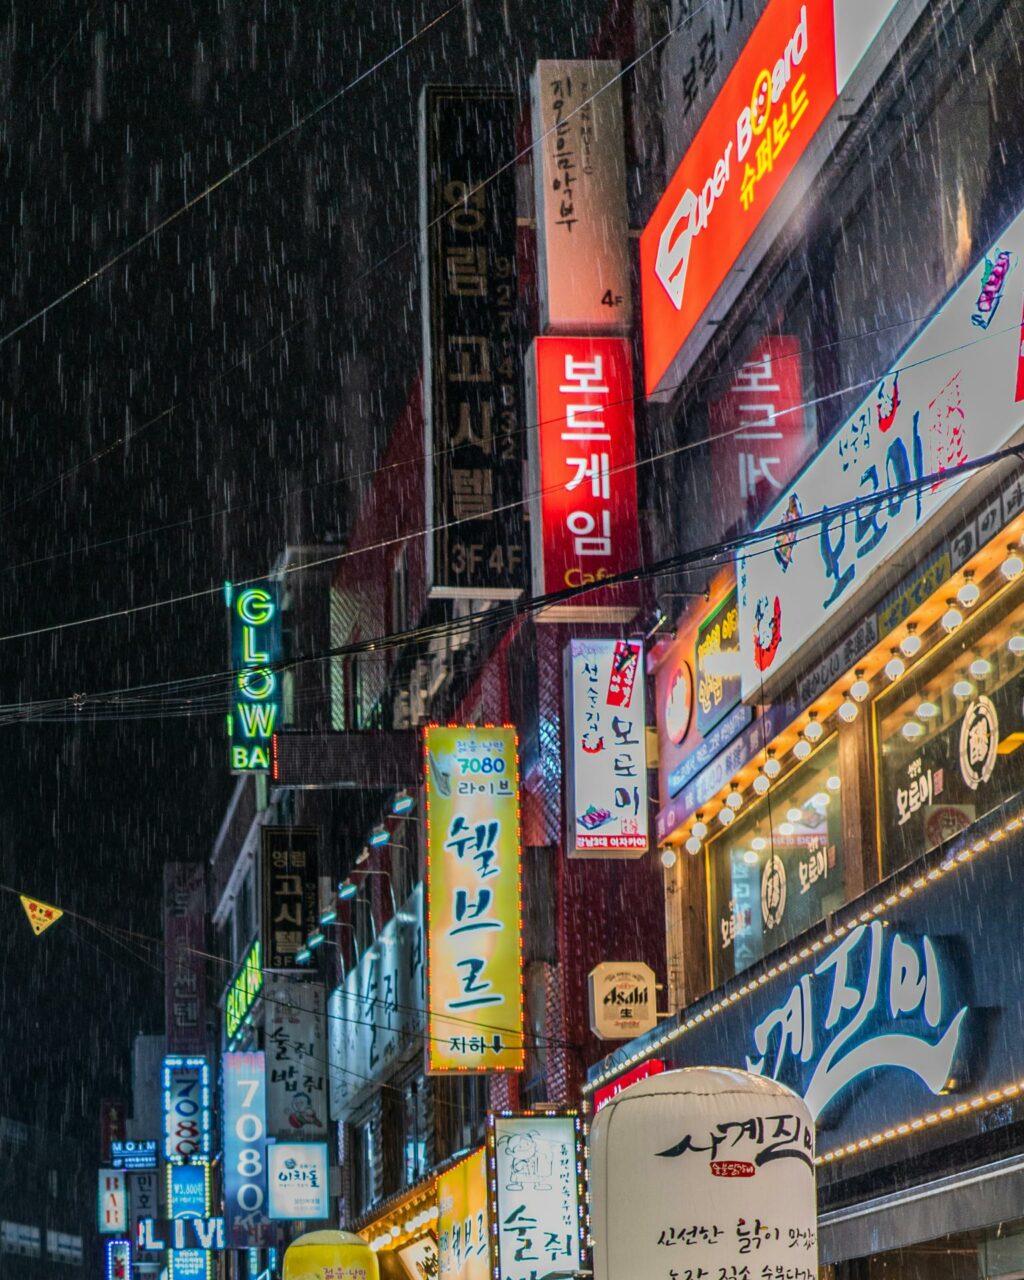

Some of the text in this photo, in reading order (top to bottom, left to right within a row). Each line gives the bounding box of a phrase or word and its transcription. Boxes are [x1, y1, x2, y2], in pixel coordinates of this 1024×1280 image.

[739, 73, 810, 211] 슈퍼보드
[655, 141, 733, 311] Super
[601, 290, 623, 308] 4F
[447, 336, 494, 523] 고시텔
[559, 355, 612, 557] 보드게임
[237, 588, 276, 736] GLOW
[457, 757, 506, 775] 7080
[458, 780, 513, 796] 라이브
[445, 816, 503, 1010] 쉘브르
[603, 986, 648, 1005] Asahi
[620, 1007, 633, 1018] 生
[449, 1036, 487, 1054] 지하
[235, 1080, 264, 1212] 7080
[657, 1225, 725, 1247] 신선한
[737, 1218, 780, 1254] 닭이
